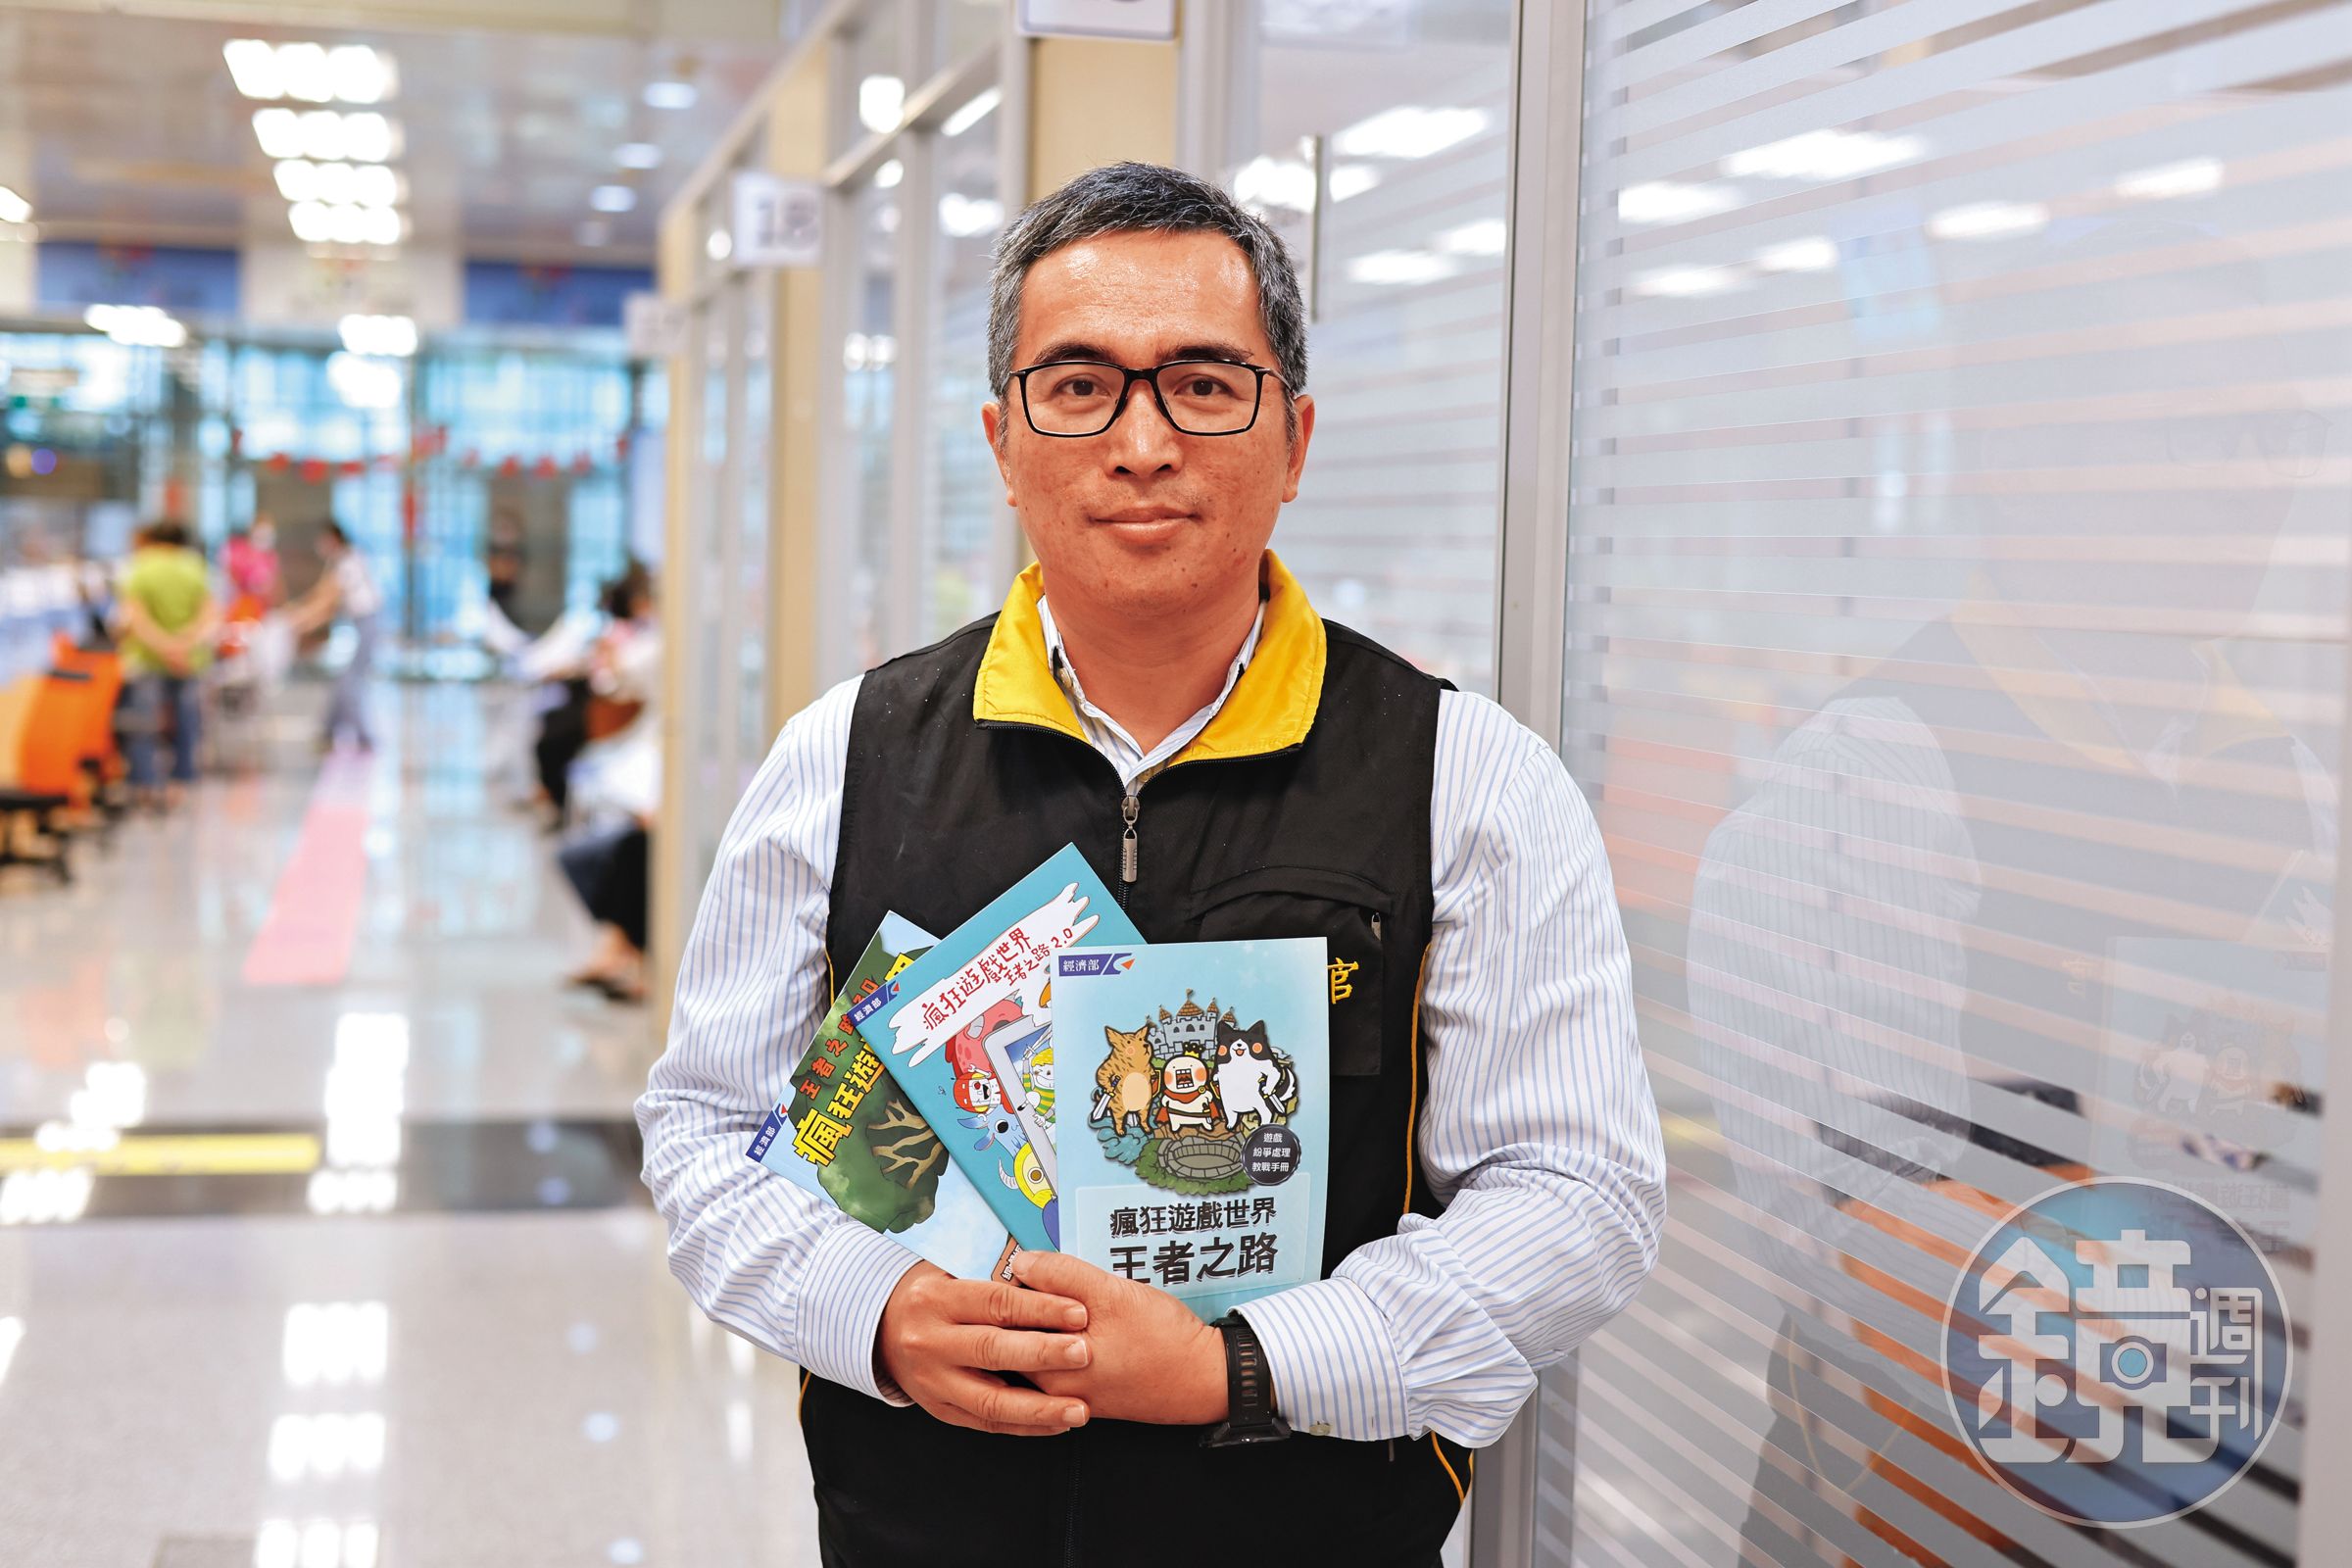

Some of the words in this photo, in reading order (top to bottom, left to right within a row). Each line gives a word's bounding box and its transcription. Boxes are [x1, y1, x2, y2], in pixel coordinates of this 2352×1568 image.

[1004, 944, 1051, 986] 王者之路
[1051, 928, 1073, 948] 2.0
[1063, 958, 1100, 972] 經濟部
[922, 927, 1032, 1030] 瘋狂遊戲世界
[1263, 1133, 1283, 1143] 遊戲
[1252, 1147, 1291, 1157] 紛爭處理
[1251, 1161, 1290, 1172] 教戰手冊
[1109, 1197, 1277, 1237] 瘋狂遊戲世界
[1109, 1231, 1278, 1287] 王者之路
